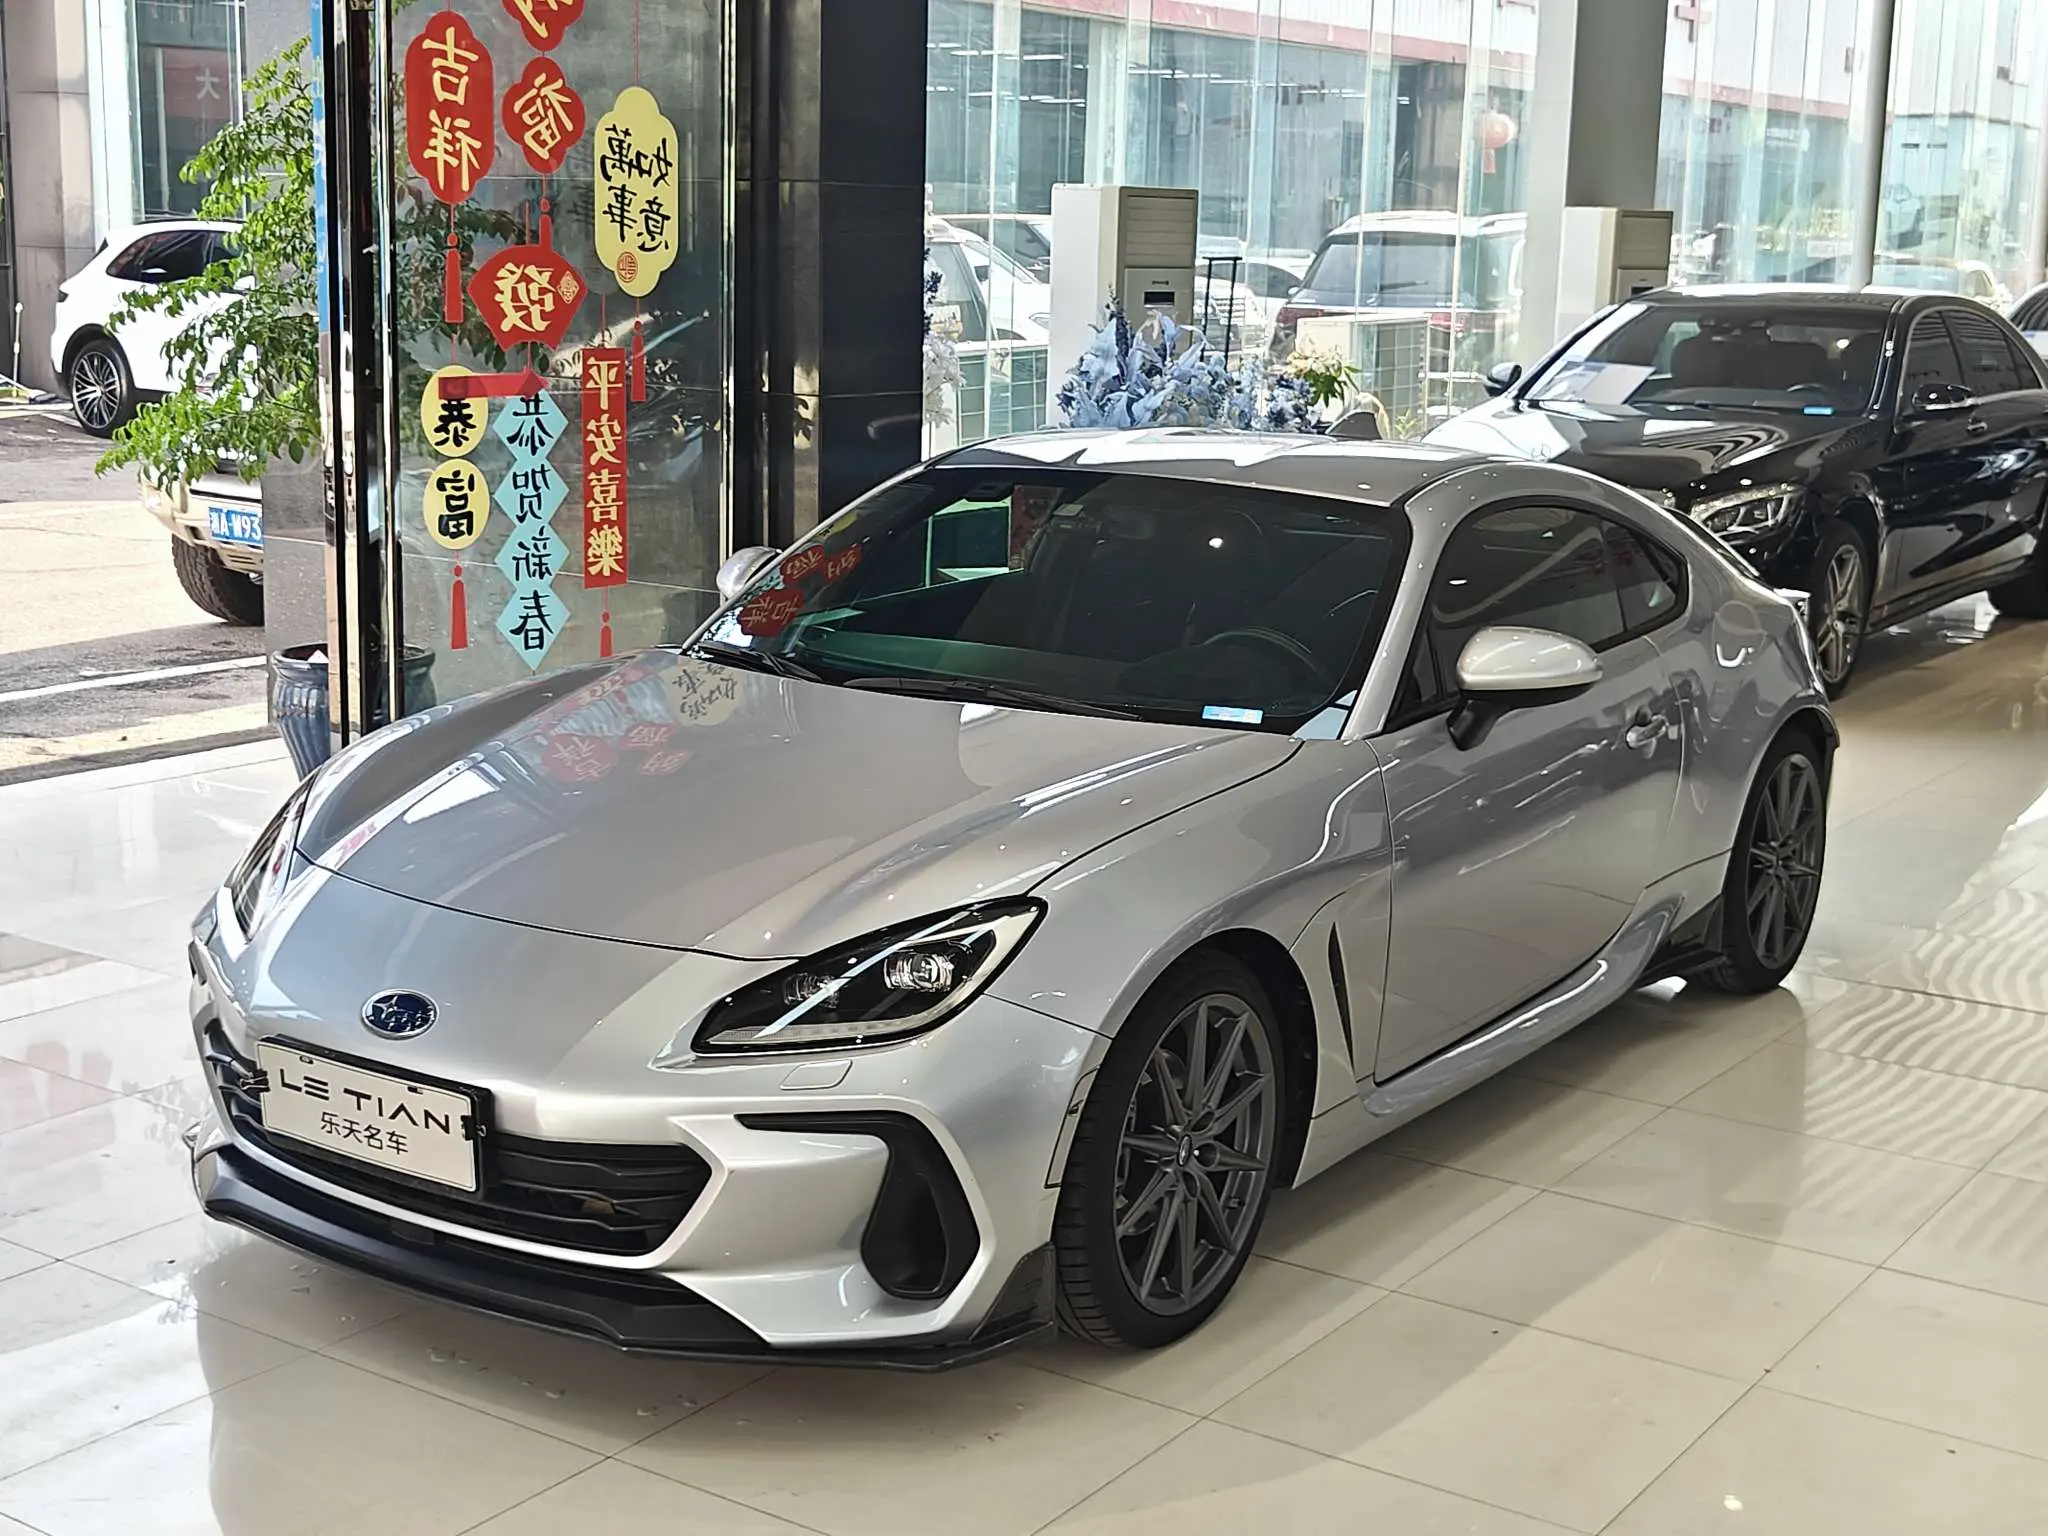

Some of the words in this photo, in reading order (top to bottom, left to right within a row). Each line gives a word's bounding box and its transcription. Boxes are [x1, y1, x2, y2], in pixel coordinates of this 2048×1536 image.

[279, 1068, 330, 1101] LE
[343, 1088, 451, 1135] TIAN
[320, 1111, 408, 1155] 乐天名车
